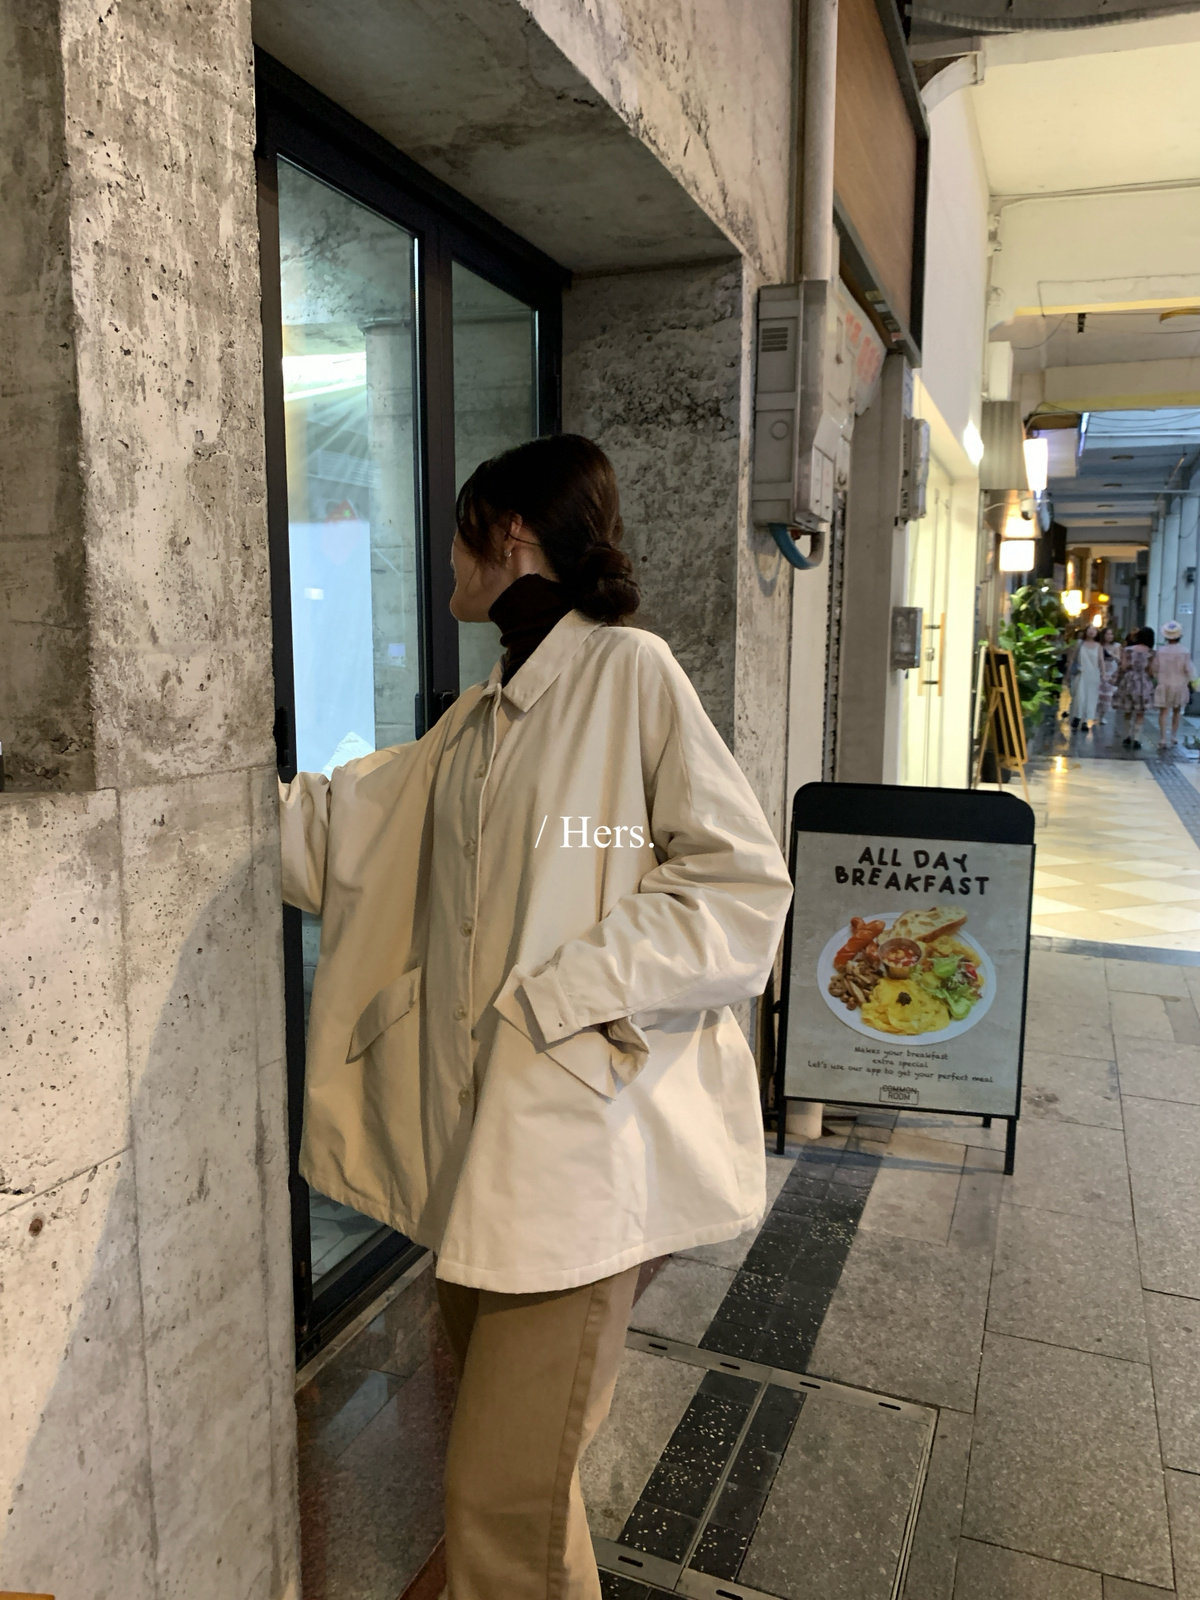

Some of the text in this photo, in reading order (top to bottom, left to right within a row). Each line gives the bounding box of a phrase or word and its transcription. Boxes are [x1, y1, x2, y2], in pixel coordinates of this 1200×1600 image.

[858, 847, 968, 873] ALL DAY
[835, 865, 990, 895] BREAKFAST
[854, 1046, 948, 1060] Makes your breakfast
[807, 1060, 828, 1069] Let's
[830, 1063, 845, 1071] use
[866, 1067, 881, 1076] app
[884, 1067, 894, 1075] to
[897, 1070, 911, 1078] get
[914, 1072, 934, 1080] your
[937, 1072, 969, 1082] perfect
[971, 1075, 994, 1083] meal
[898, 1061, 929, 1069] special
[882, 1085, 918, 1095] COMMON
[888, 1092, 911, 1101] ROOM
